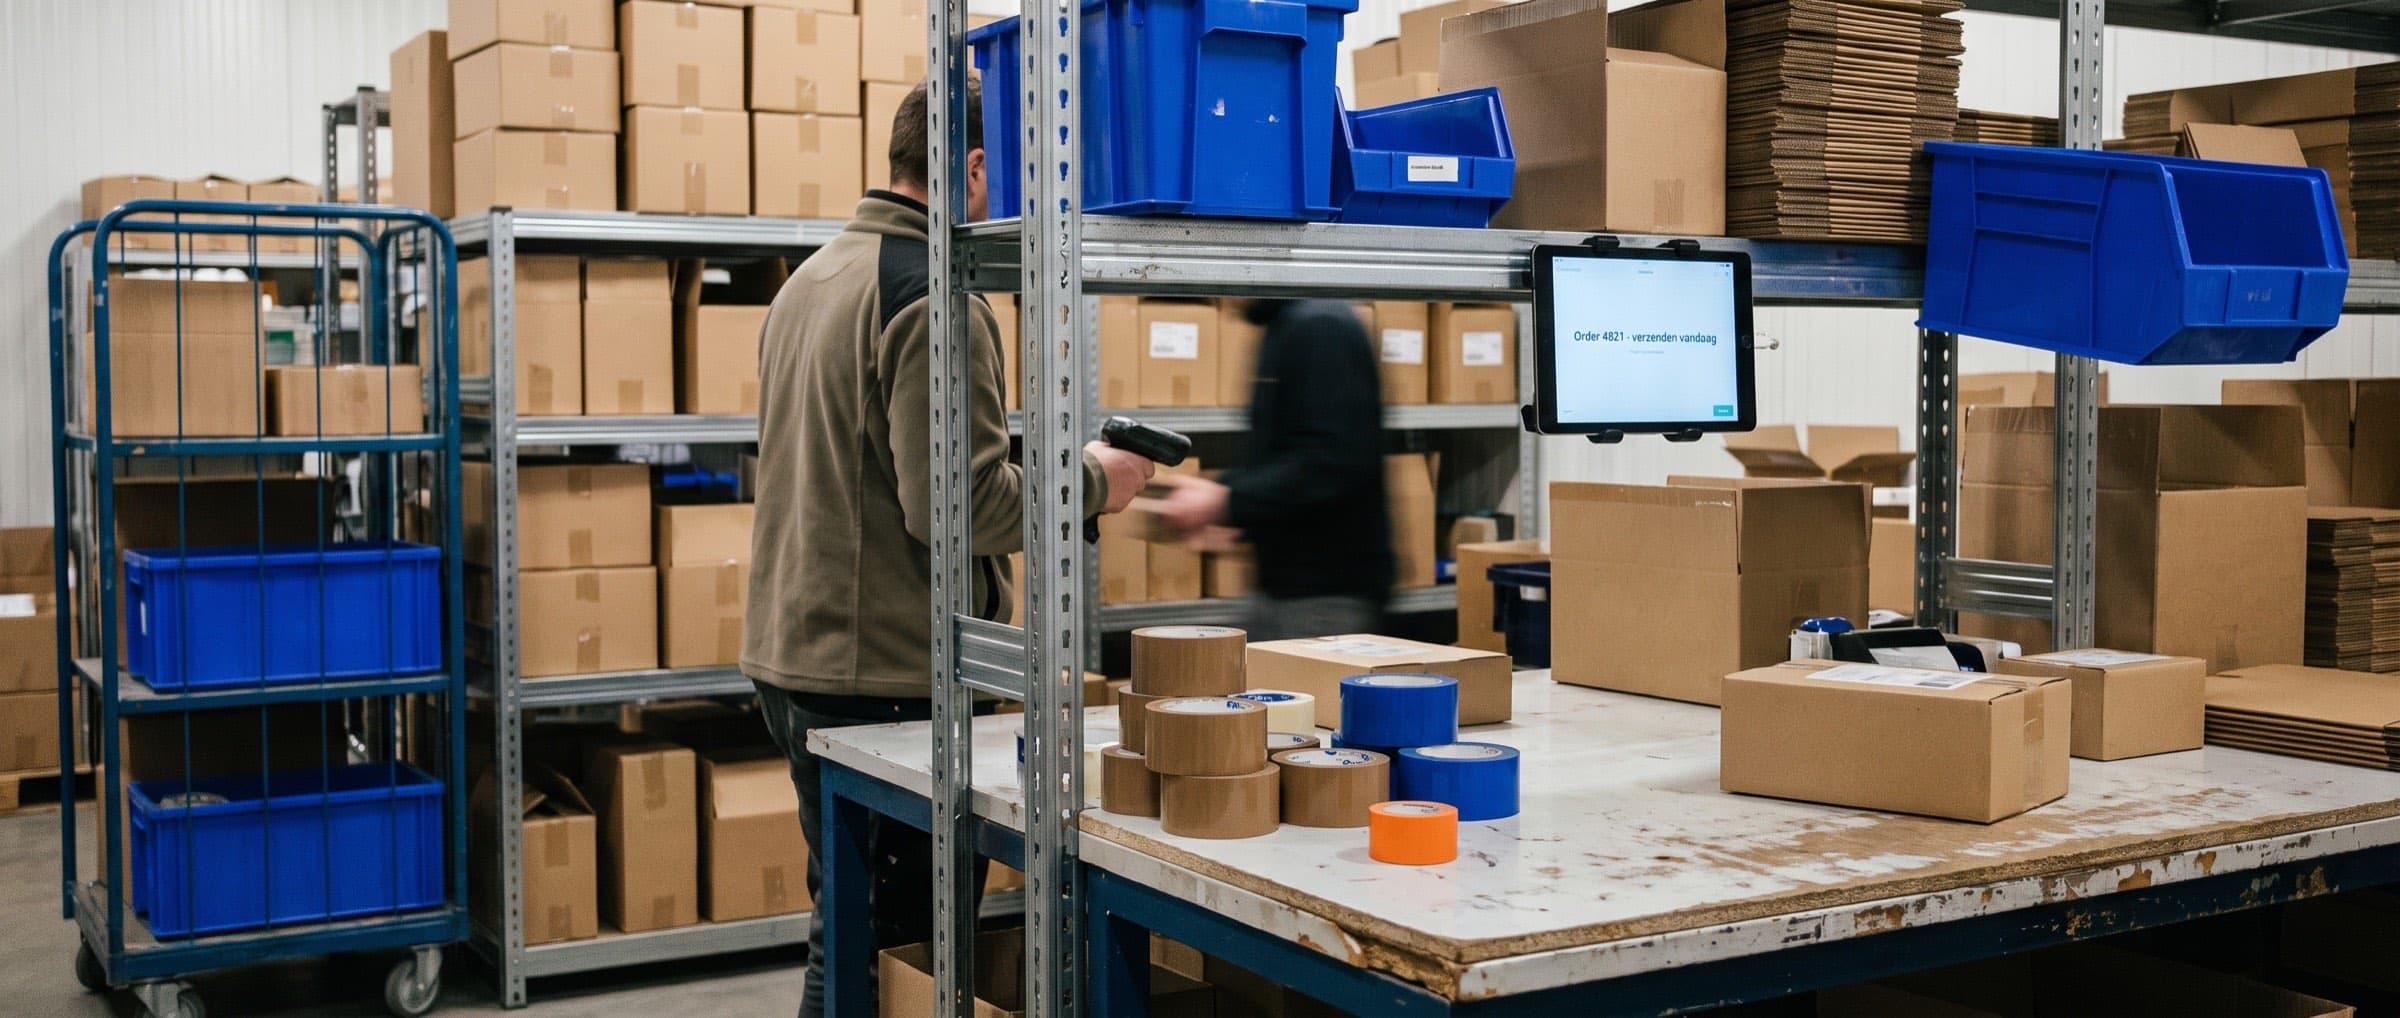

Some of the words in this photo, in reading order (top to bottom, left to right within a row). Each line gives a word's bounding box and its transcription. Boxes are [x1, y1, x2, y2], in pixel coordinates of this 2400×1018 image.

[1574, 330, 1601, 342] Order
[1602, 330, 1624, 342] 4821
[1631, 331, 1678, 343] verzenden
[1679, 332, 1717, 346] vandaag
